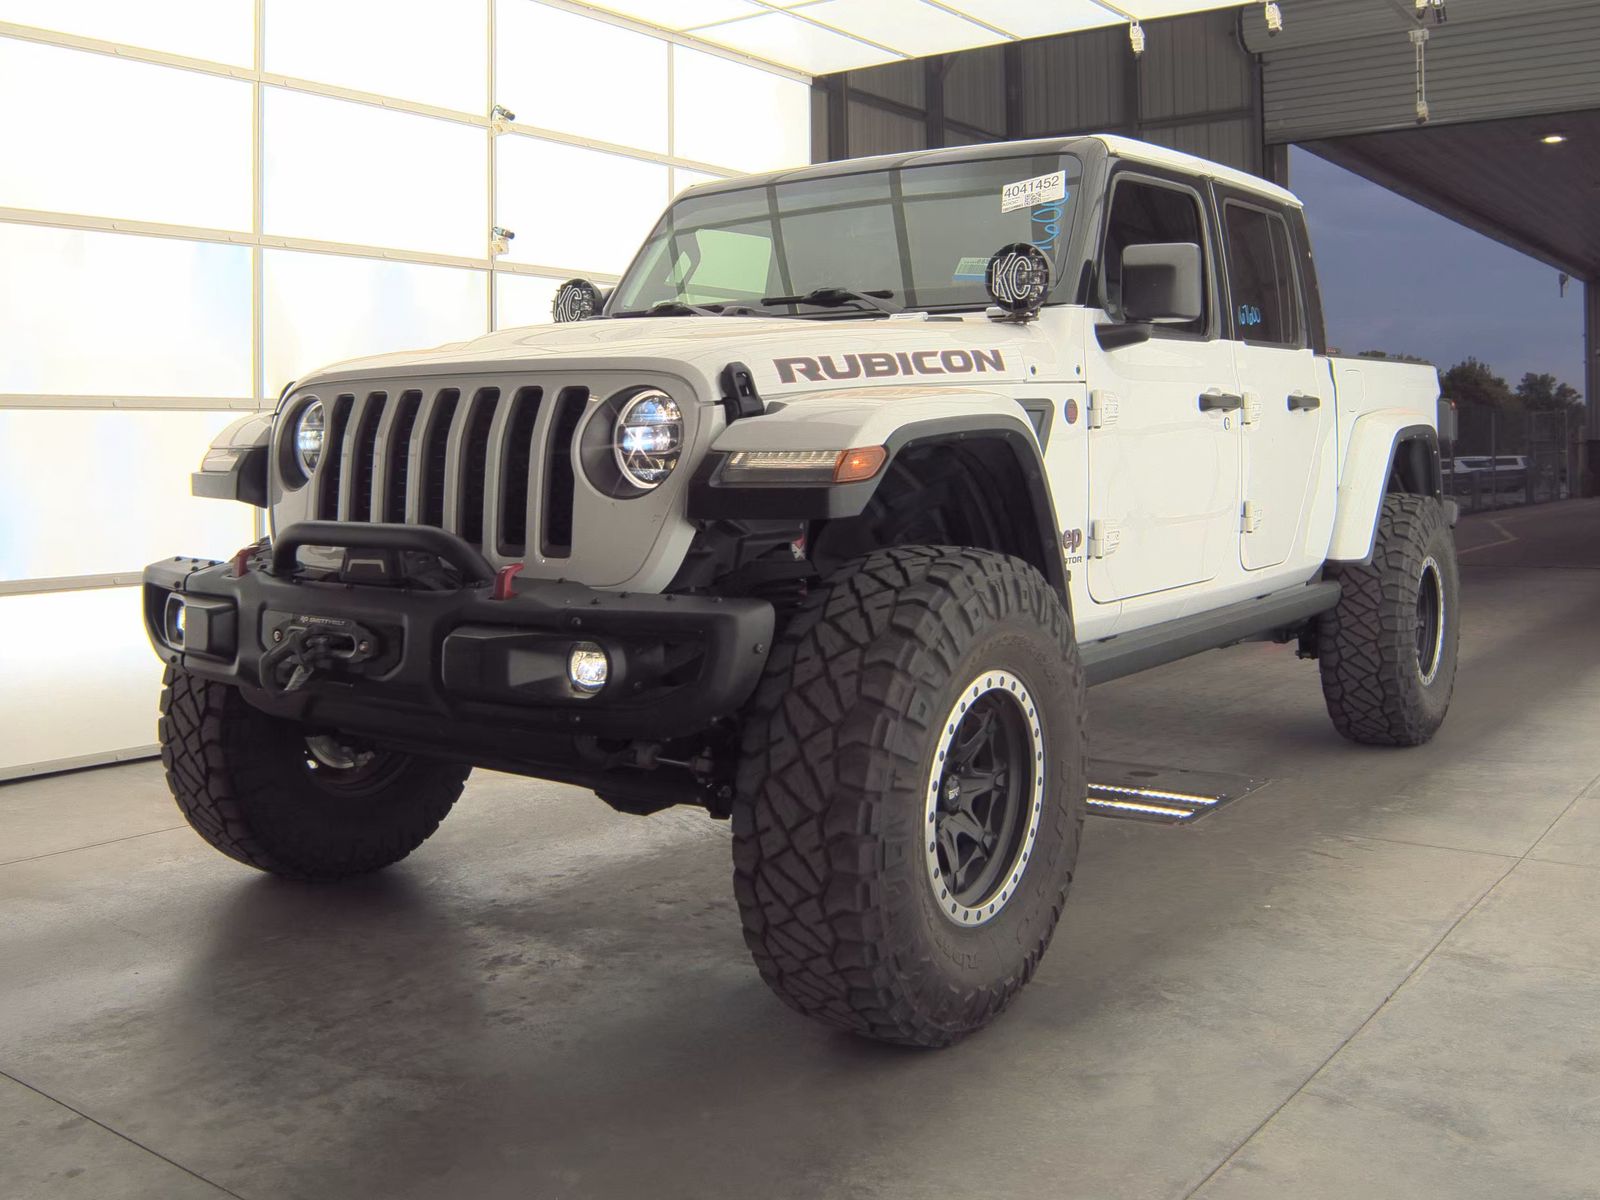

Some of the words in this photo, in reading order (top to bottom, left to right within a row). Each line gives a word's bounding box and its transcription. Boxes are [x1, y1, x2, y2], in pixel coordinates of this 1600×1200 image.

[1004, 174, 1060, 199] 4041452
[991, 252, 1032, 303] KC
[552, 285, 582, 323] KC
[772, 349, 1006, 384] RUBICON
[1062, 527, 1083, 553] ep
